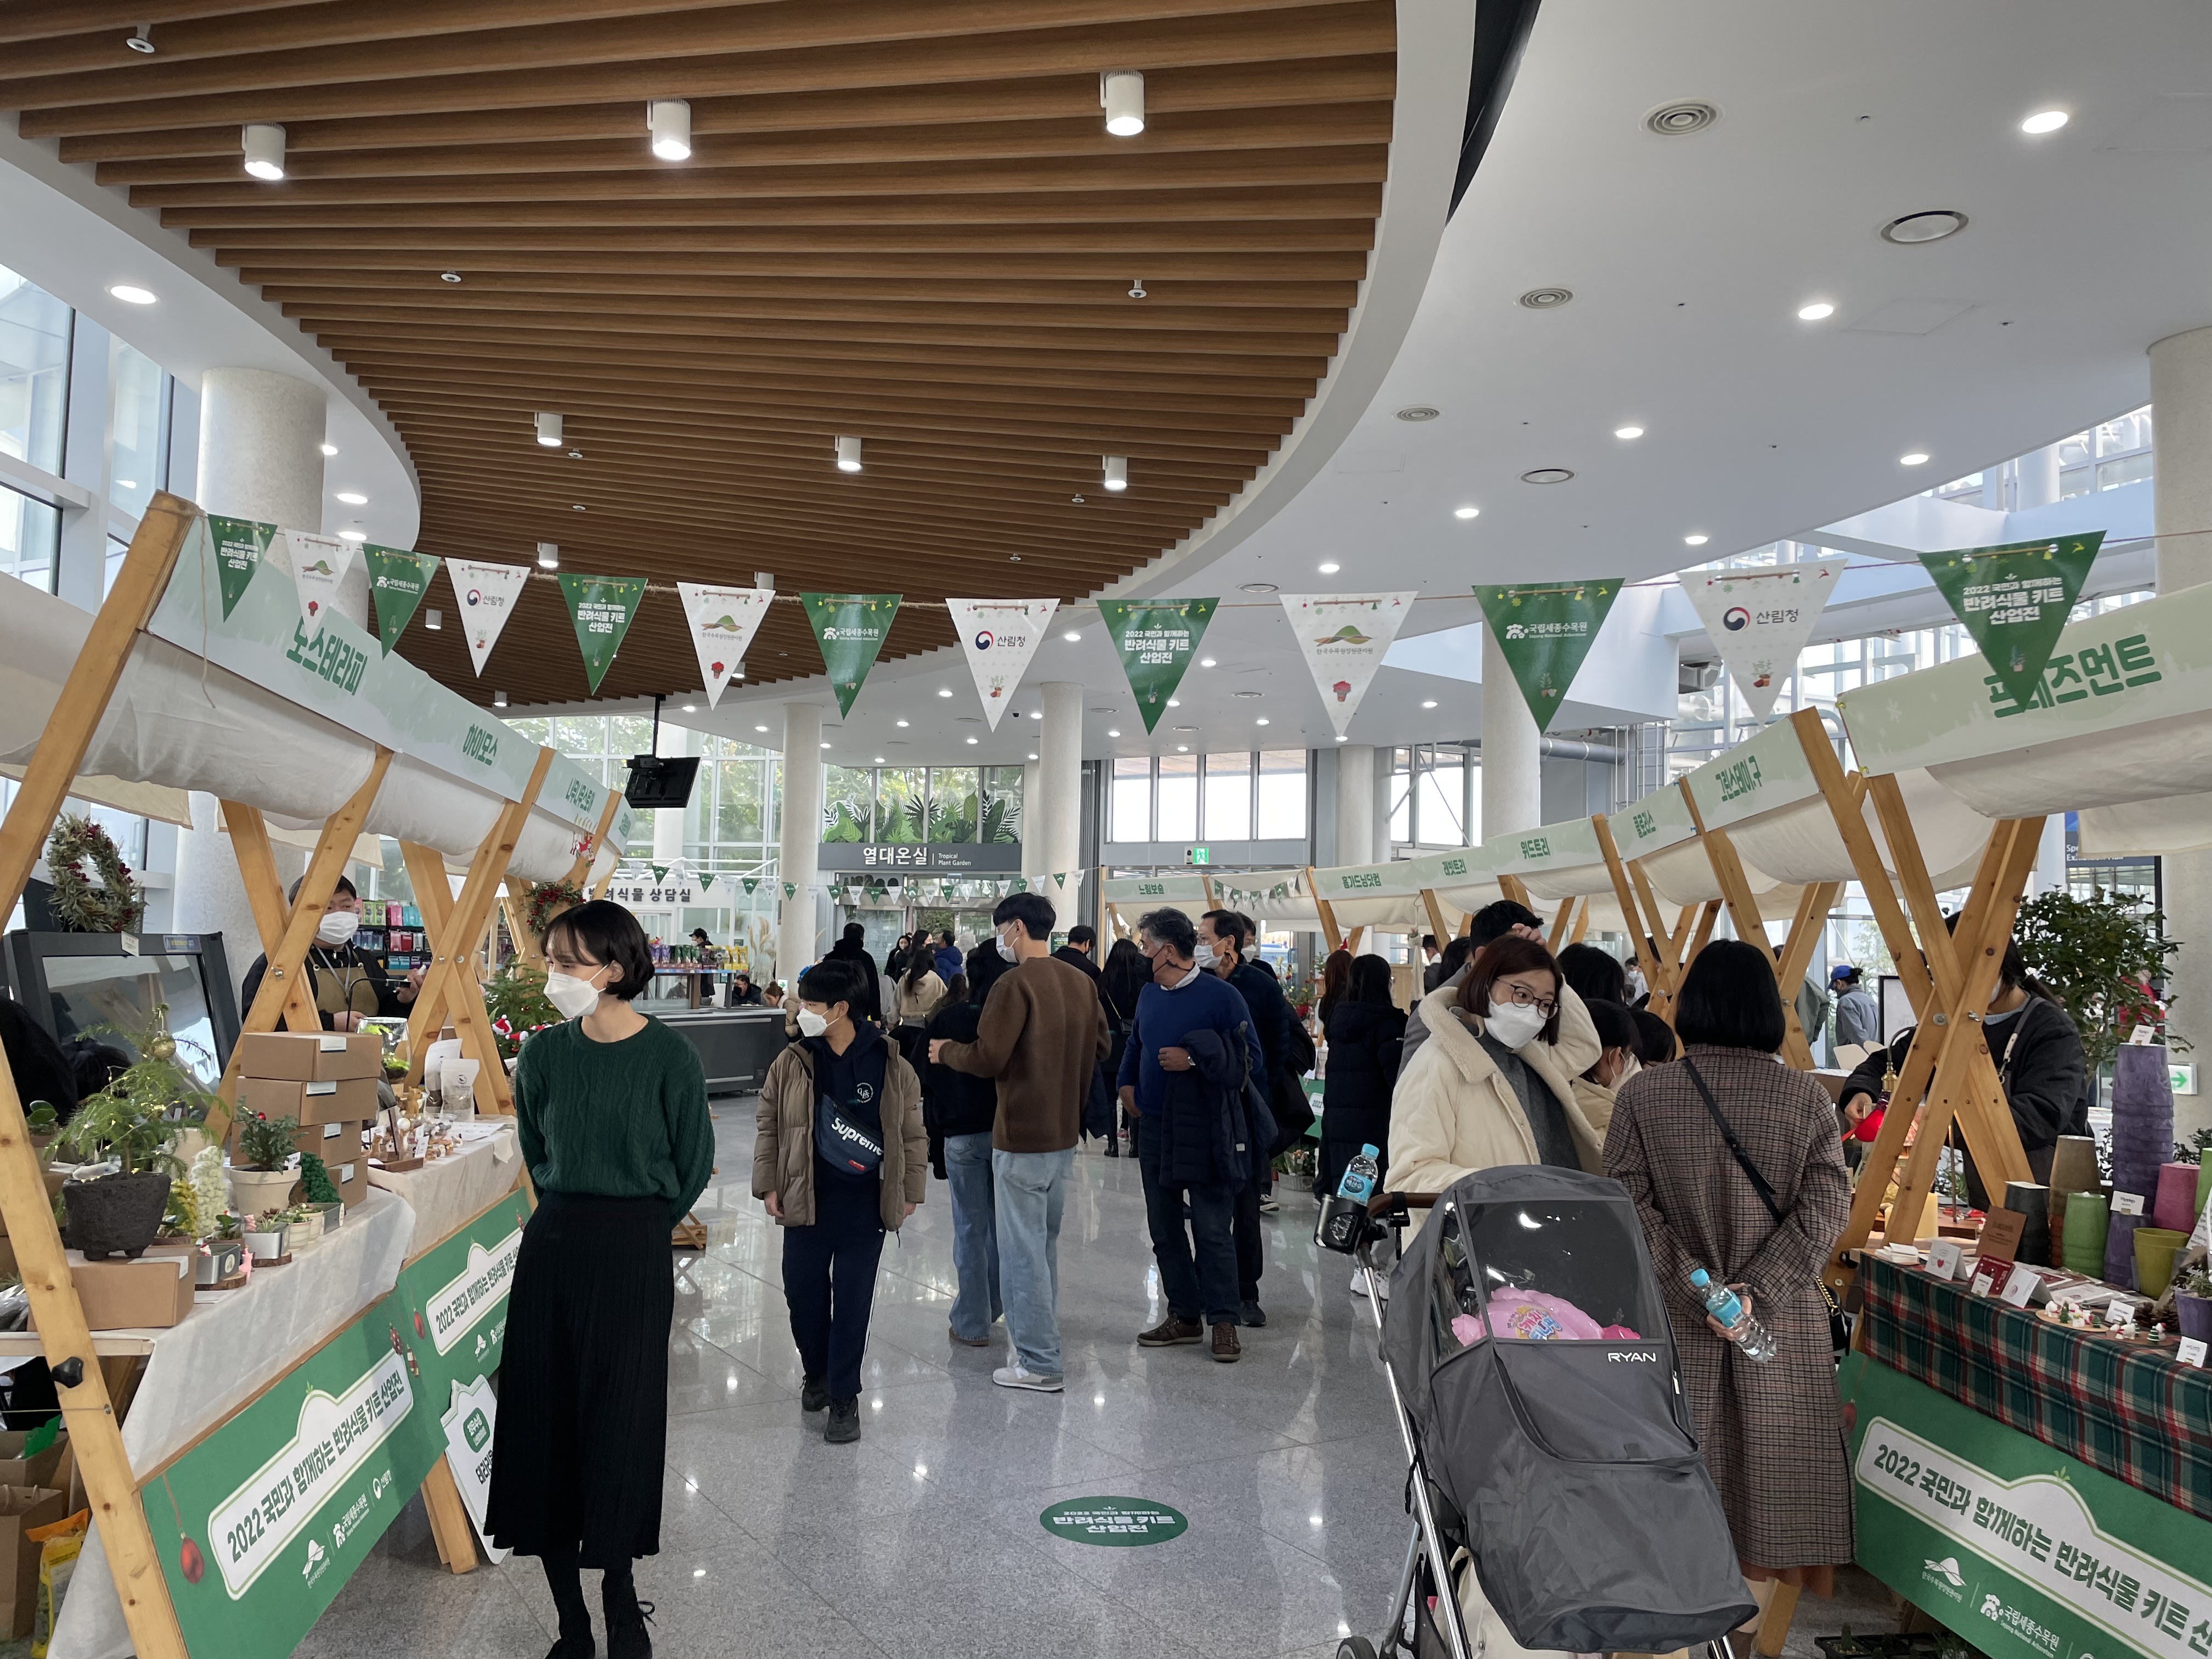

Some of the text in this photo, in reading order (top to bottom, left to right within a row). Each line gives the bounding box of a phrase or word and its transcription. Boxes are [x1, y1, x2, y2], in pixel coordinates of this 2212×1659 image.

[1963, 585, 1991, 595] 2022
[483, 594, 505, 607] 산림청
[1963, 586, 2065, 612] 반려식물 키트
[610, 612, 625, 623] 키트
[1756, 608, 1799, 624] 산림청
[1989, 606, 2041, 625] 산업전
[588, 622, 613, 634] 산업전
[1528, 622, 1588, 634] 국립세종수목원
[997, 635, 1026, 648] 산림청
[1125, 639, 1189, 651] 반려식물 키트
[1140, 652, 1172, 664] 산업전
[462, 723, 499, 766] 하이모스
[863, 847, 928, 866] 열대온실
[1521, 837, 1551, 860] 위드트리
[1341, 872, 1382, 889] 홈가드닝닷컴
[650, 888, 691, 902] 상담실
[1138, 883, 1165, 895] 느림보숲
[831, 1117, 883, 1156] Supreme
[436, 1305, 455, 1335] 2022
[1607, 1352, 1656, 1362] RYAN
[227, 1507, 265, 1564] 2022
[261, 1475, 296, 1525] 국민과
[292, 1440, 336, 1496] 함께하는
[332, 1404, 369, 1456] 반려식물
[365, 1390, 383, 1423] 키트
[381, 1369, 405, 1410] 산업전
[1874, 1444, 1920, 1487] 2022
[1920, 1467, 1972, 1515] 국민과
[1972, 1496, 2052, 1563] 함께하는
[2053, 1541, 2141, 1613] 반려식물
[2140, 1588, 2191, 1642] 키트
[2003, 1605, 2060, 1652] 국립세종수목원
